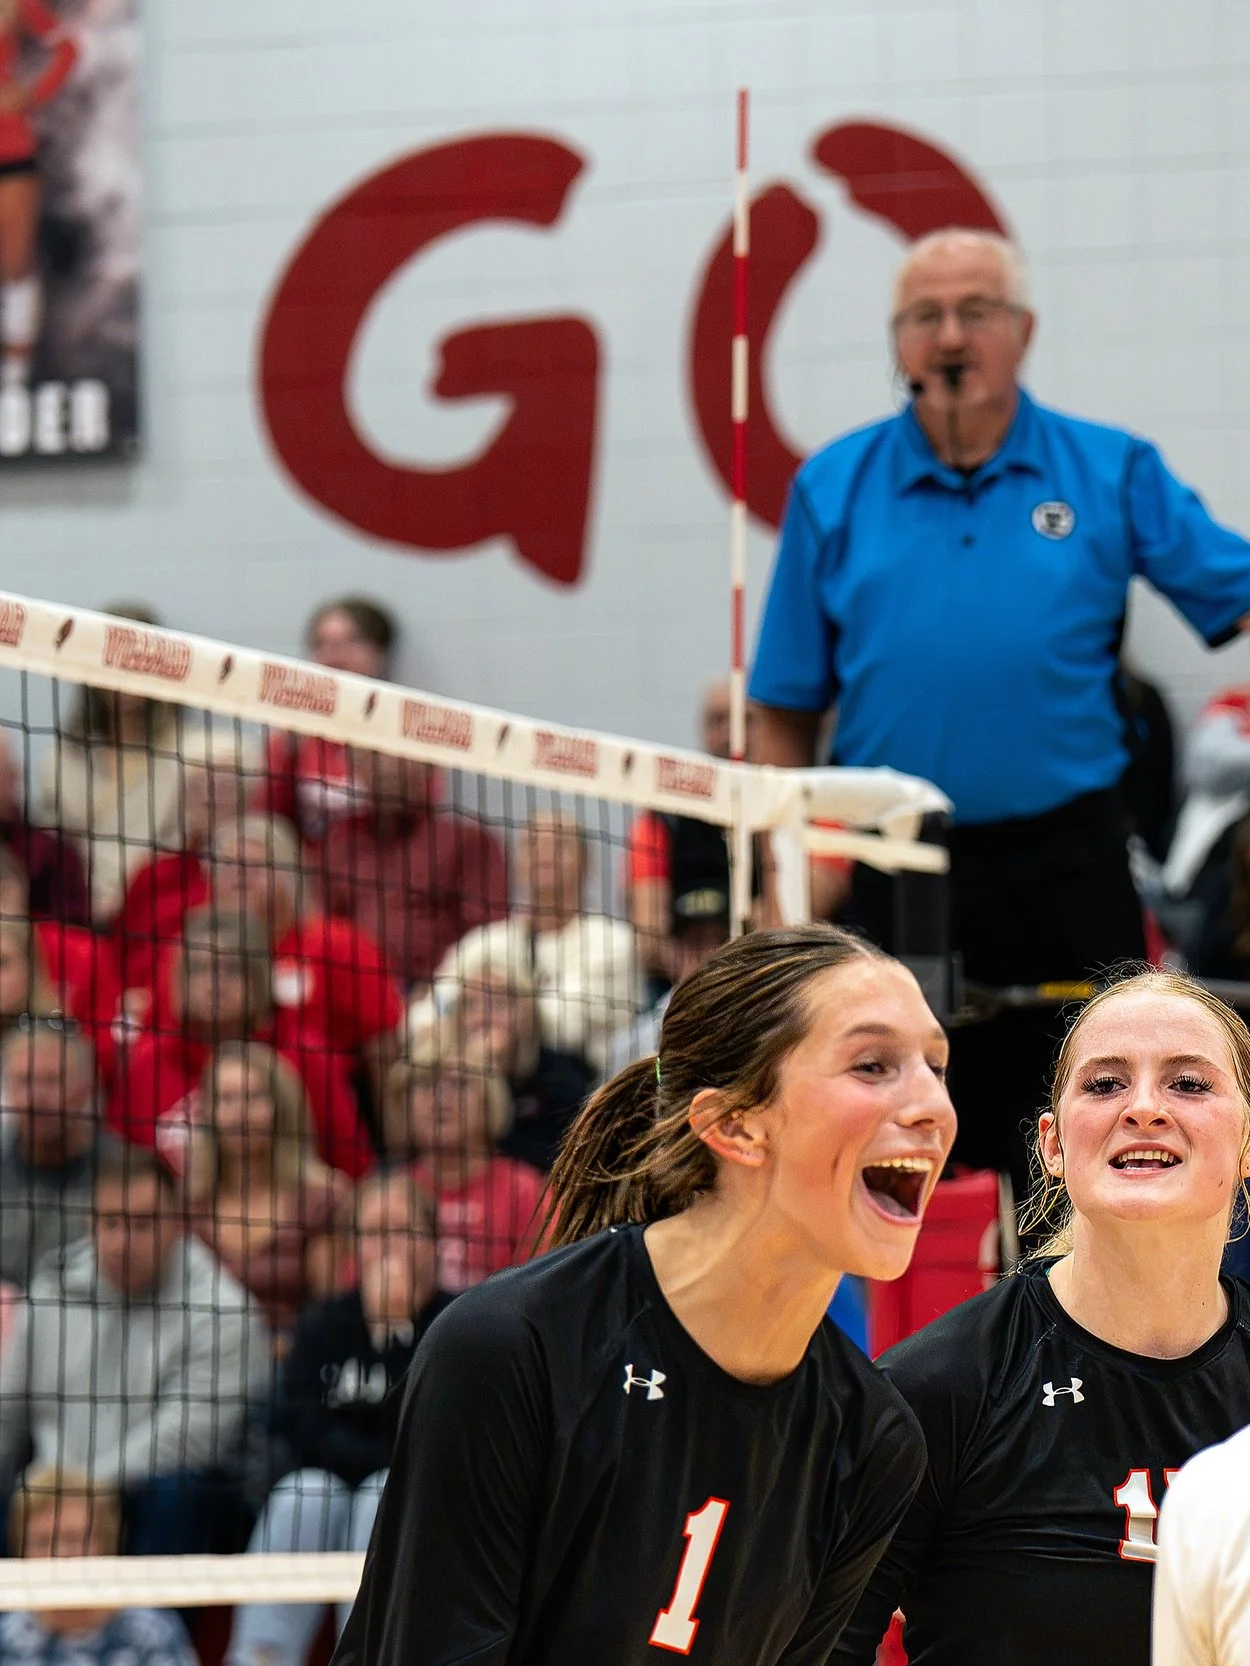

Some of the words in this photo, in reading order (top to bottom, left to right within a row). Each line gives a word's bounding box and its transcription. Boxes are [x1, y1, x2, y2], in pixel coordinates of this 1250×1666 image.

[258, 122, 1007, 586] GO
[648, 1496, 730, 1656] 1
[1113, 1468, 1183, 1562] 1
